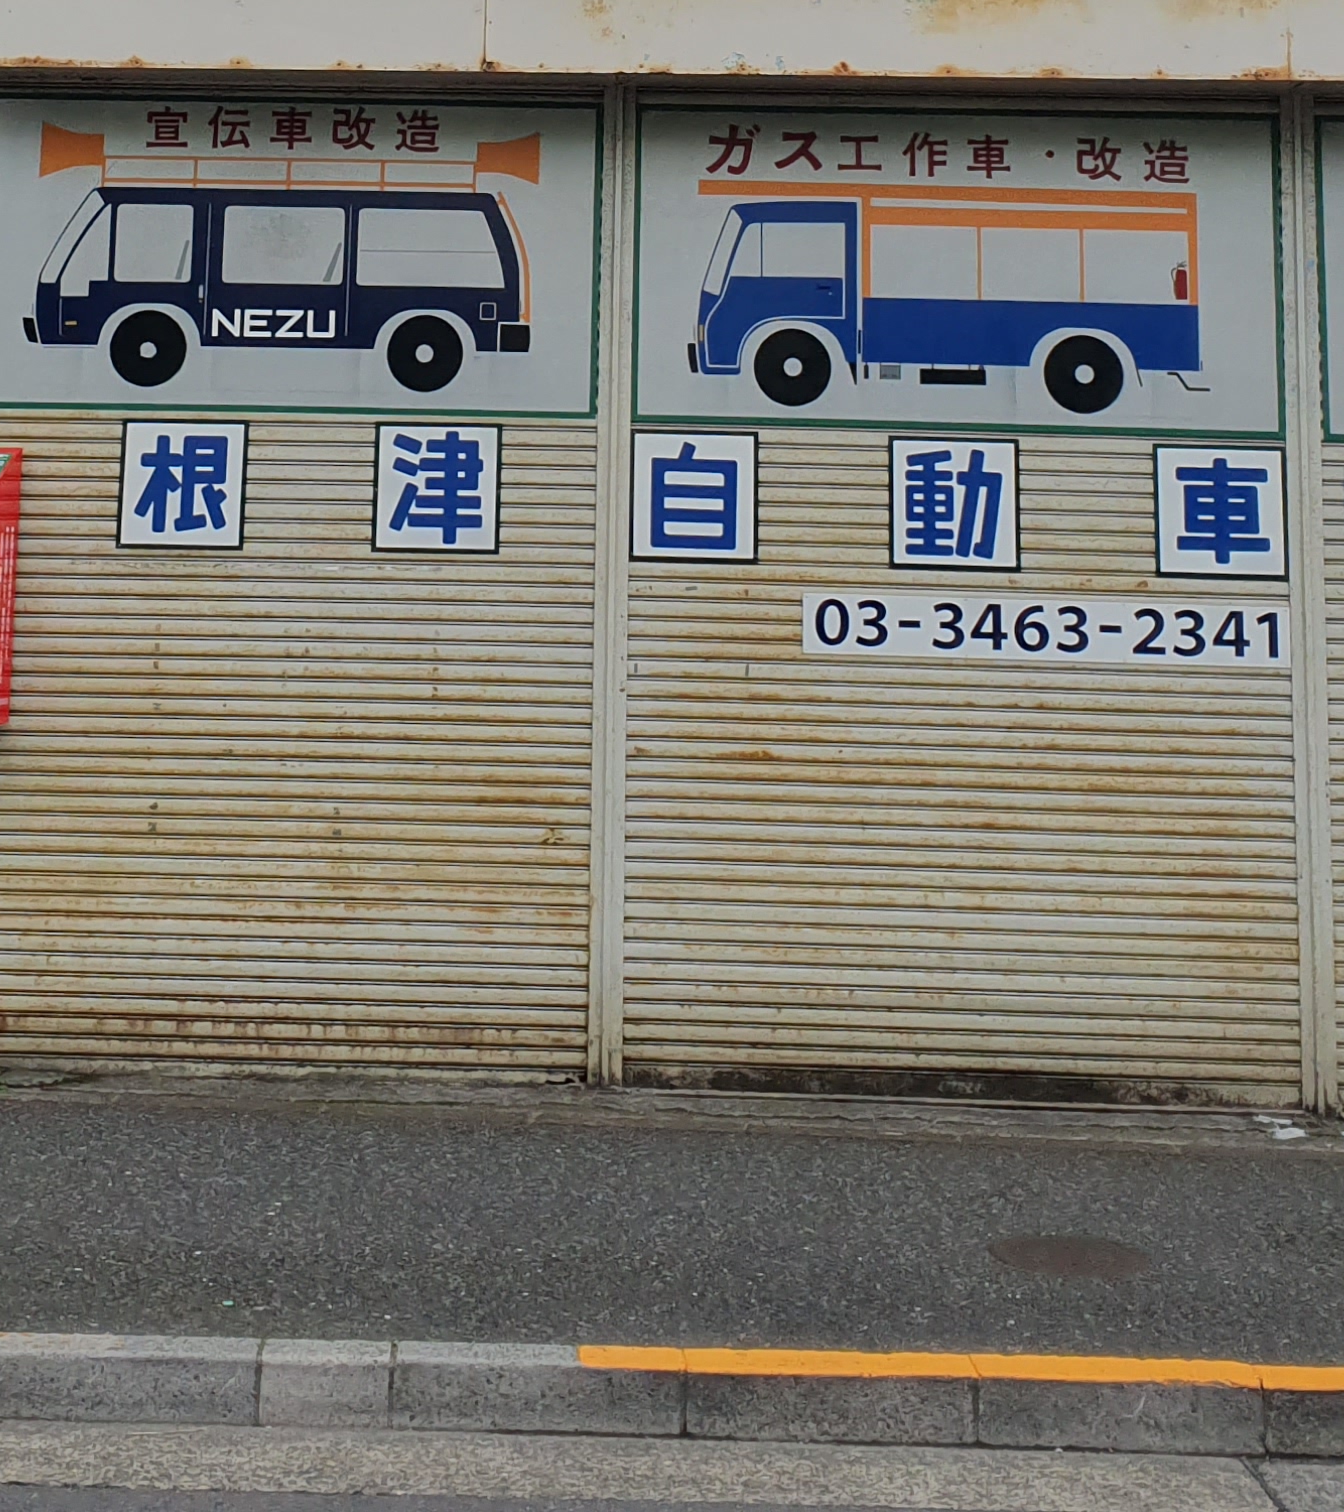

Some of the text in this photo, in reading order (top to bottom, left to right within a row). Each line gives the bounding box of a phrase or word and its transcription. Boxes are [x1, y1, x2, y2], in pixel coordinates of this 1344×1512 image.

[146, 104, 441, 153] 宣伝車改造
[706, 123, 1192, 184] ガス工作車・改造
[210, 307, 336, 339] NEZU
[814, 596, 1281, 659] 03-3463-2341
